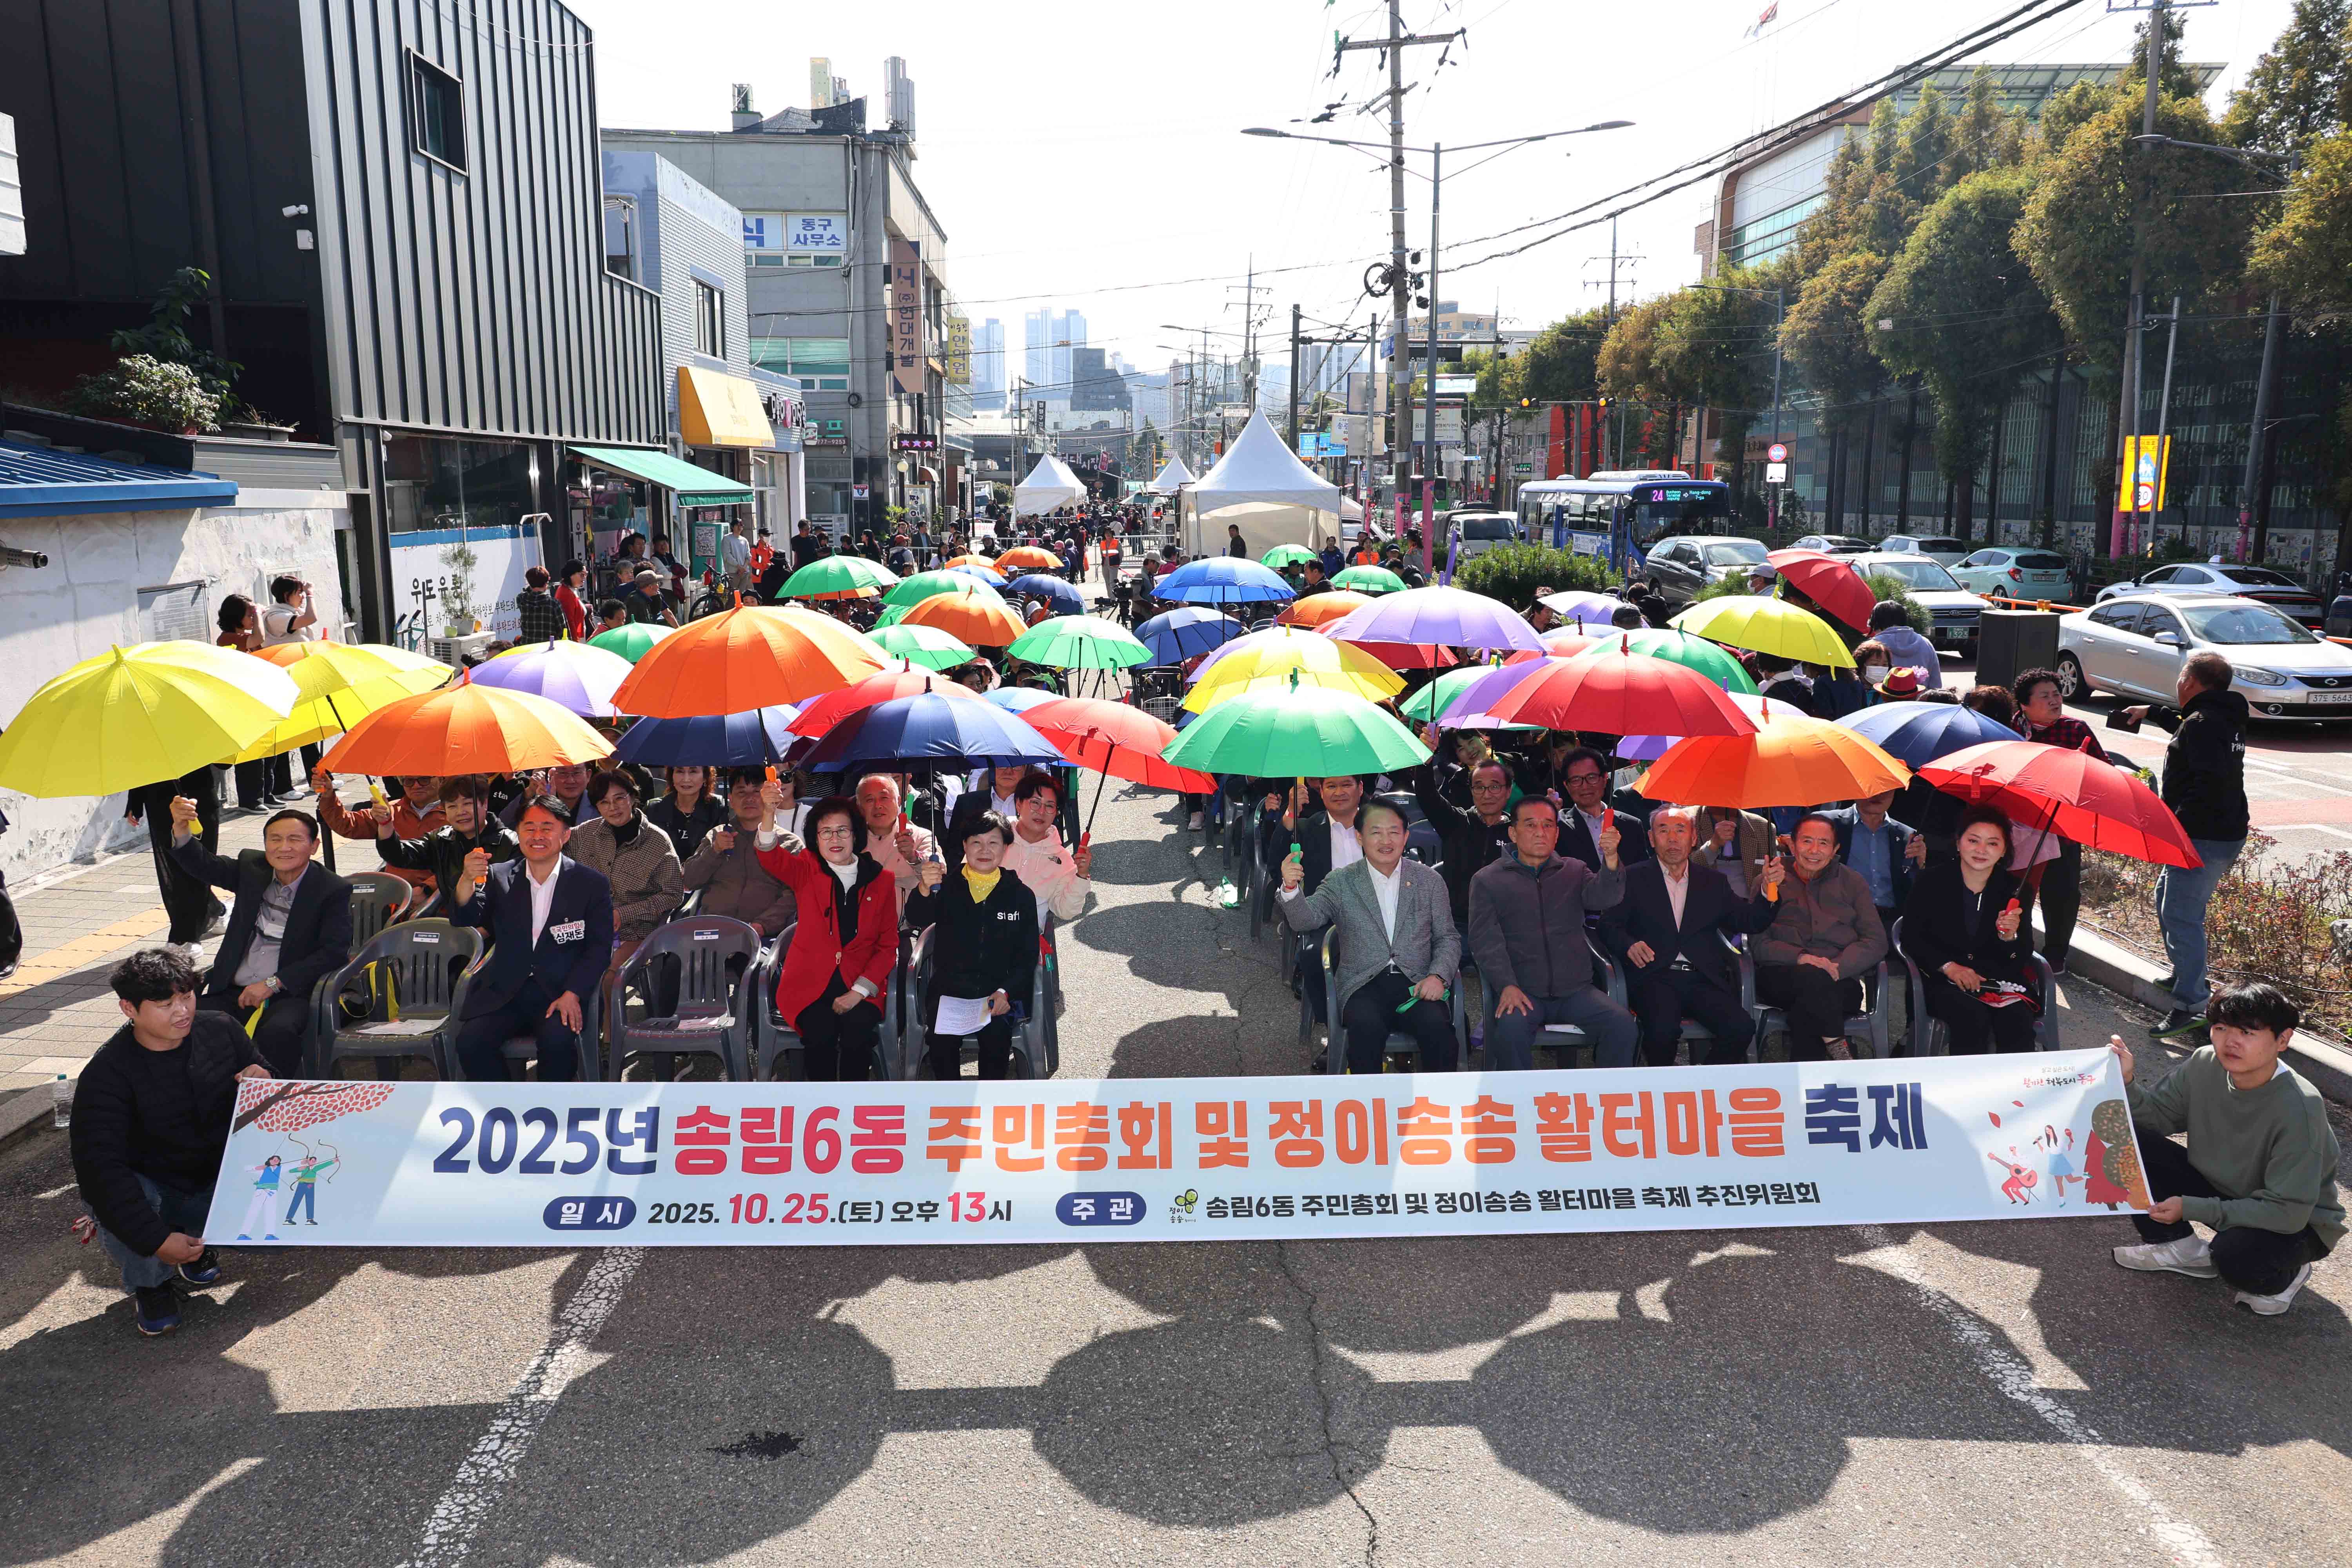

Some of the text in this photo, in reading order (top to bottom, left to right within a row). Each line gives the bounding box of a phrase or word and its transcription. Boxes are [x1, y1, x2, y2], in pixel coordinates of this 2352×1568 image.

[802, 218, 832, 231] 동구
[793, 234, 840, 246] 사무소
[951, 323, 967, 332] 이승진
[1652, 490, 1663, 501] 24
[495, 597, 520, 615] 부탁드려
[556, 922, 581, 933] 국민의힘
[556, 929, 583, 943] 심재돈
[2045, 1077, 2076, 1087] 행복도시
[2077, 1073, 2095, 1085] 동구
[433, 1083, 1929, 1175] 2025년 송림6동 주민총회 및 정이송송 활터마을 축제
[1206, 1181, 1821, 1218] 송림6동 주민총회 및 정이송송 활터마을 축제 추진위원회
[648, 1203, 720, 1223] 2025.
[730, 1193, 774, 1224] 10.
[890, 1200, 939, 1222] 오후
[948, 1192, 1012, 1222] 13시
